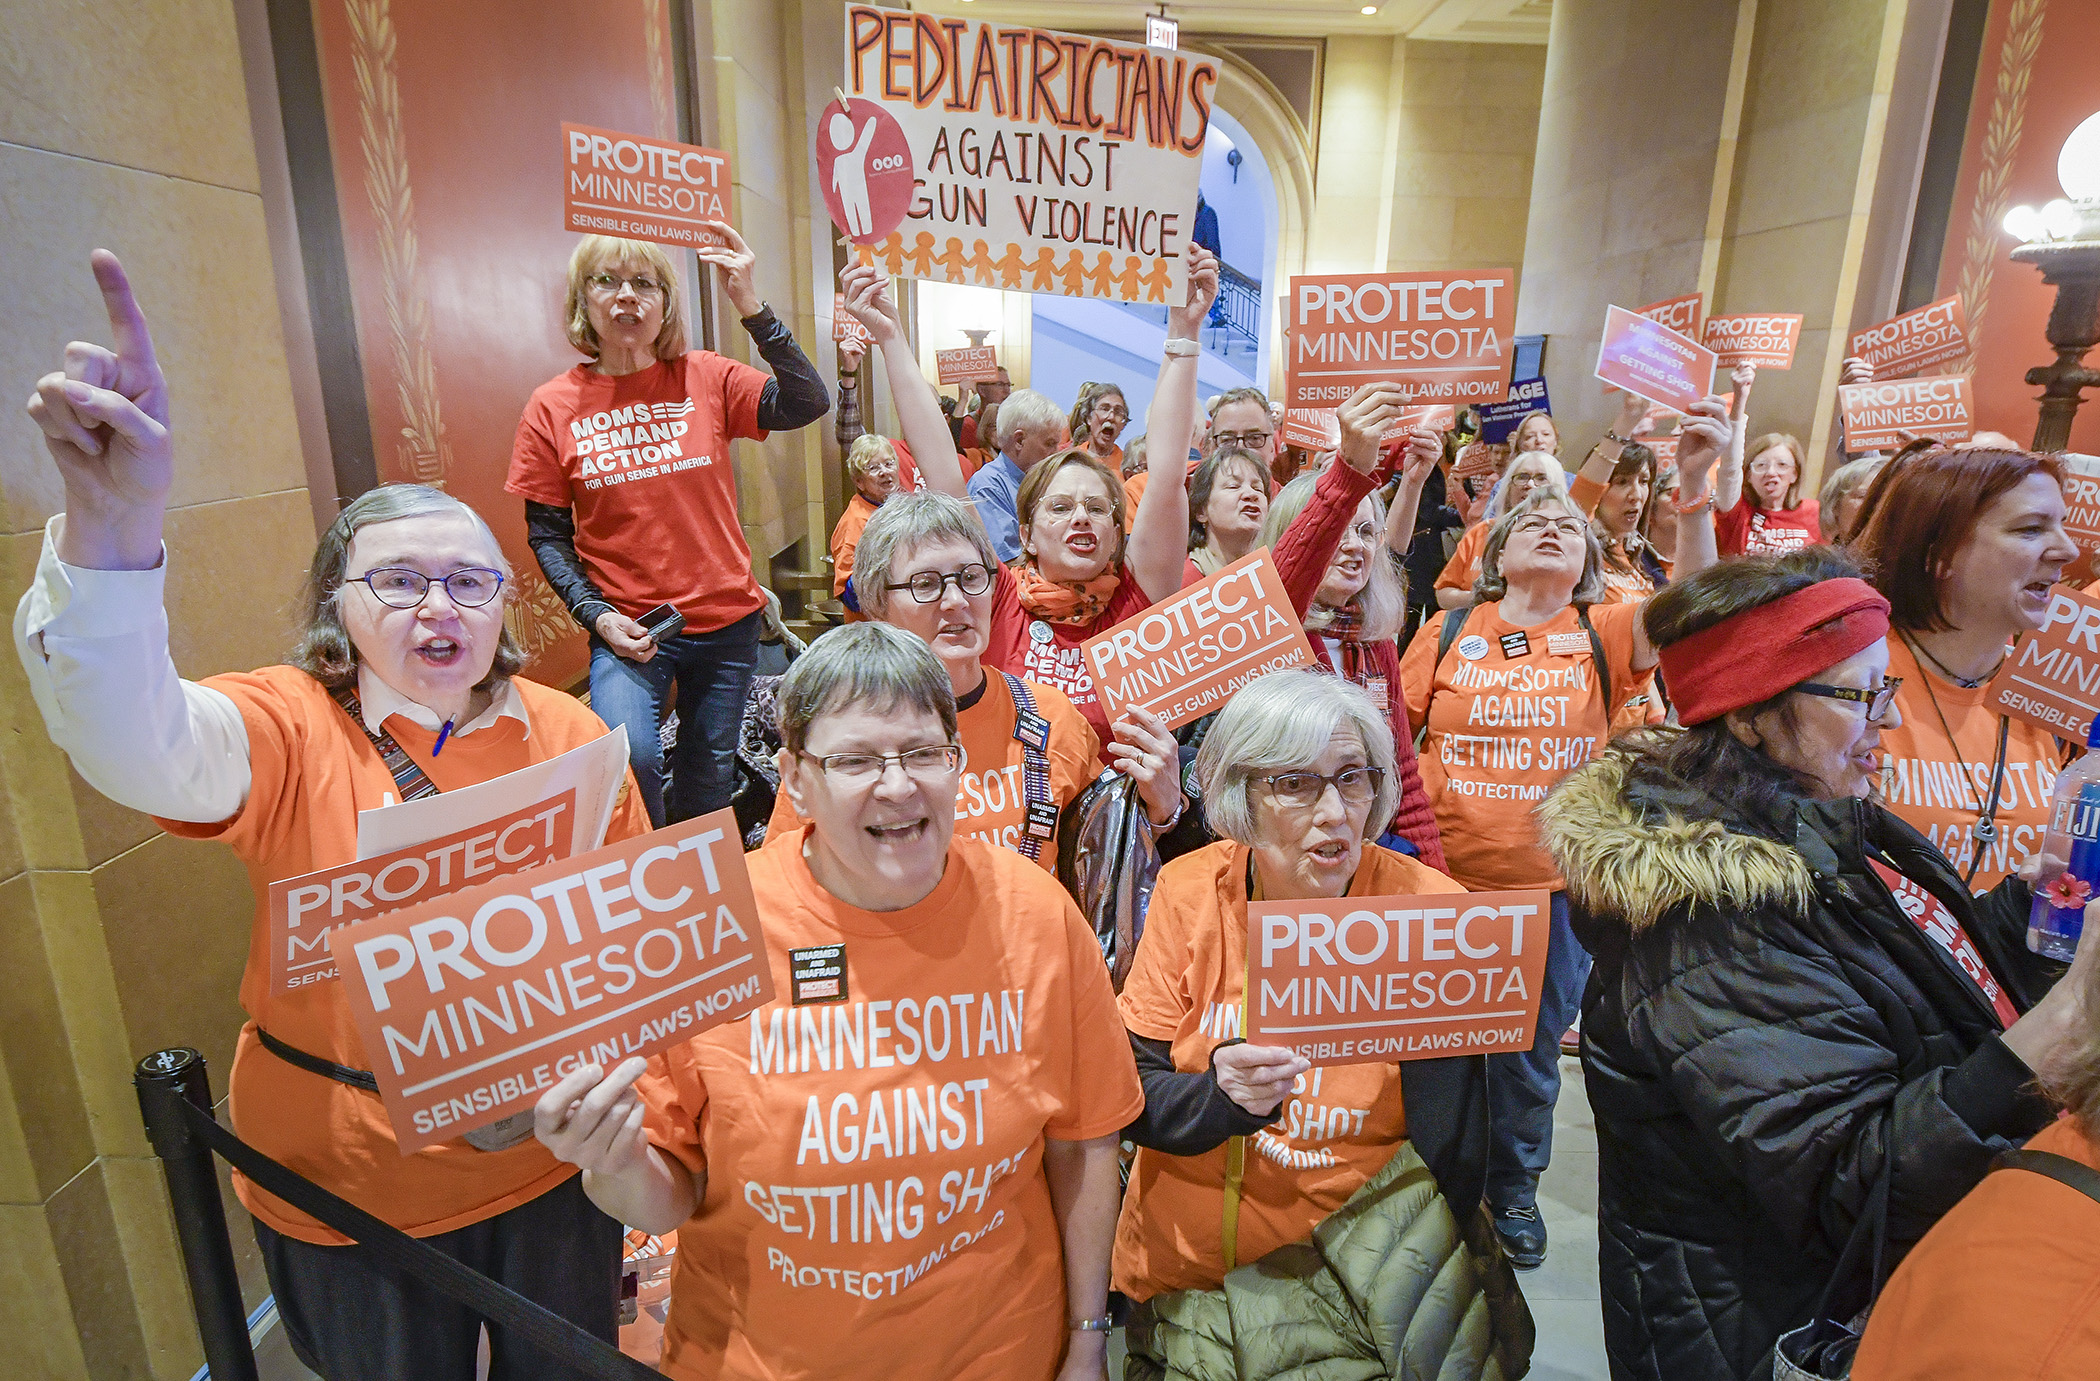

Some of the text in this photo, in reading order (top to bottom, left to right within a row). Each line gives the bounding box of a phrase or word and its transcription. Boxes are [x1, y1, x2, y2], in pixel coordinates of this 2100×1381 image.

[850, 9, 1217, 157] PEDIATRICIANS
[570, 131, 724, 188] PROTECT
[928, 126, 1120, 191] AGAINST
[571, 170, 725, 217] MINNESOTA
[572, 213, 725, 246] SENSIBLE GUN LAWS NOW!
[907, 178, 1180, 258] GUN VIOLENCE
[1300, 279, 1504, 325] PROTECT
[1298, 327, 1502, 364] MINNESOTA
[1629, 323, 1697, 362] MINNESOTAN
[1702, 336, 1790, 351] MINNESOTA
[1706, 317, 1797, 337] PROTECT
[1853, 300, 1957, 353] PROTECT
[938, 347, 993, 363] PROTECT
[940, 360, 995, 373] MINNESOTA
[1619, 354, 1666, 380] GETTING
[1666, 374, 1696, 393] SHOT
[1638, 345, 1684, 371] AGAINST
[1410, 382, 1453, 397] LAWS
[1456, 381, 1500, 396] NOW!
[1845, 378, 1965, 409] PROTECT
[570, 403, 652, 440] MOMS
[1848, 402, 1968, 428] MINNESOTA
[576, 420, 689, 456] DEMAND
[1851, 436, 1893, 448] SENSIBLE
[581, 440, 684, 477] ACTION
[584, 455, 713, 491] FOR GUN SENSE IN AMERICA
[1090, 558, 1266, 679] PROTECT
[1547, 632, 1588, 641] PROTECT
[1104, 604, 1290, 711] MINNESOTA
[1450, 660, 1587, 692] MINNESOTAN
[1087, 693, 1097, 703] IN
[1184, 687, 1220, 713] GUN
[1468, 694, 1570, 727] AGAINST
[1998, 688, 2077, 733] SENSIBLE
[1441, 733, 1596, 771] GETTING SHOT
[2053, 801, 2100, 839] FIJI
[287, 802, 567, 928] PROTECT
[354, 827, 725, 1013] PROTECT
[1261, 905, 1538, 968] PROTECT
[794, 948, 840, 962] UNARMED
[795, 966, 841, 980] UNAFRAID
[381, 904, 748, 1076] MINNESOTA
[1260, 966, 1528, 1017] MINNESOTA
[749, 989, 1024, 1075] MINNESOTAN
[1287, 1027, 1524, 1061] NSIBLE GUN LAWS NOW!
[413, 974, 762, 1135] SENSIBLE GUN LAWS NOW!
[796, 1078, 989, 1166] AGAINST
[1288, 1099, 1371, 1141] SHOT
[744, 1176, 925, 1246] GETTING
